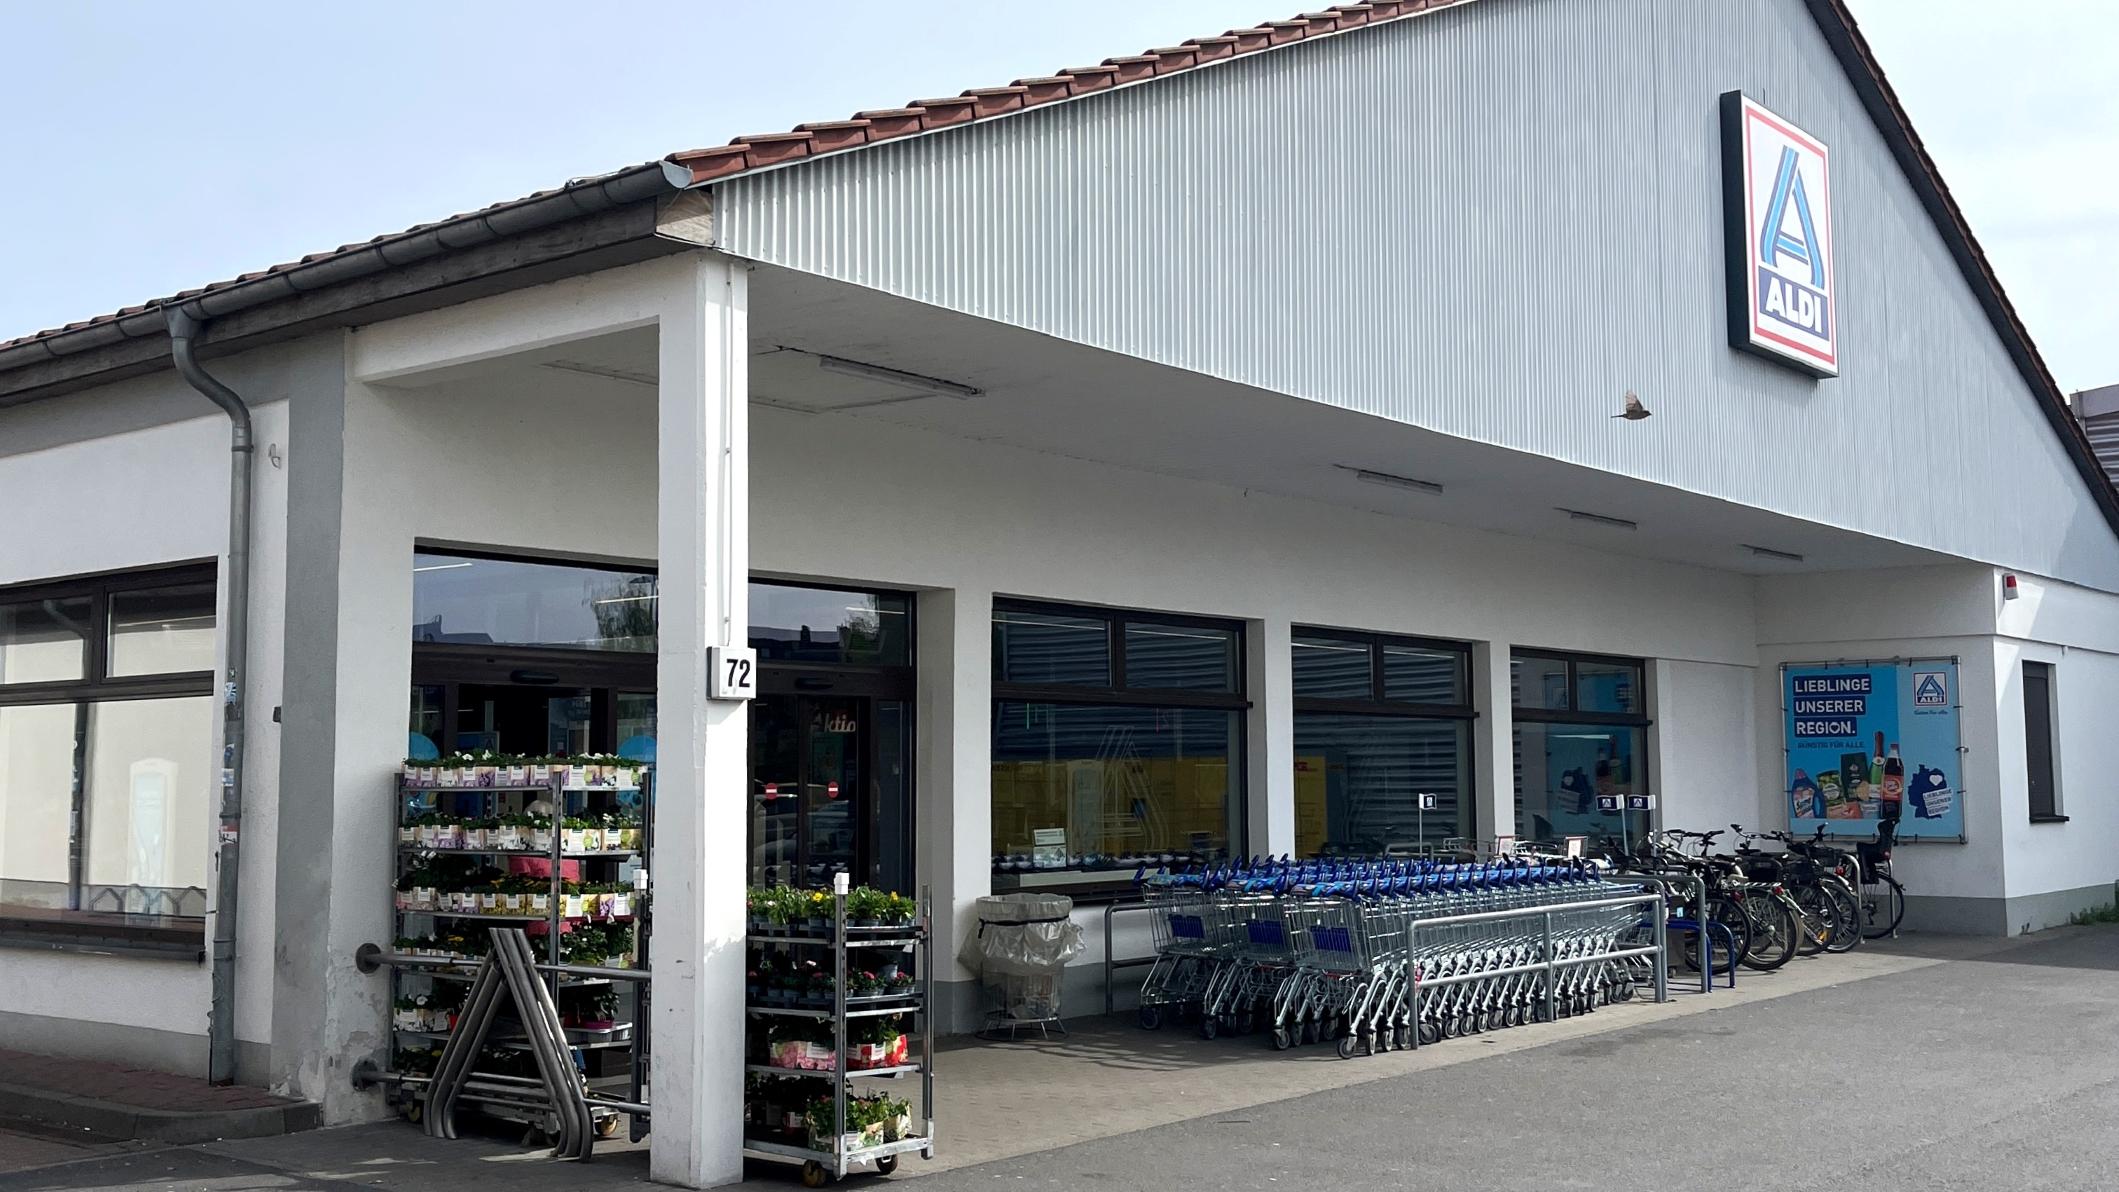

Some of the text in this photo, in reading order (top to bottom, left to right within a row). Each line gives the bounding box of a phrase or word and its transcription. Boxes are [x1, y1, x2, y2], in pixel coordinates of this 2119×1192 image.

[1765, 276, 1823, 333] ALDI
[726, 658, 750, 688] 72
[1795, 679, 1870, 693] LIEBLINGE
[1795, 699, 1864, 713] UNSERER
[1796, 721, 1856, 735] REGION.
